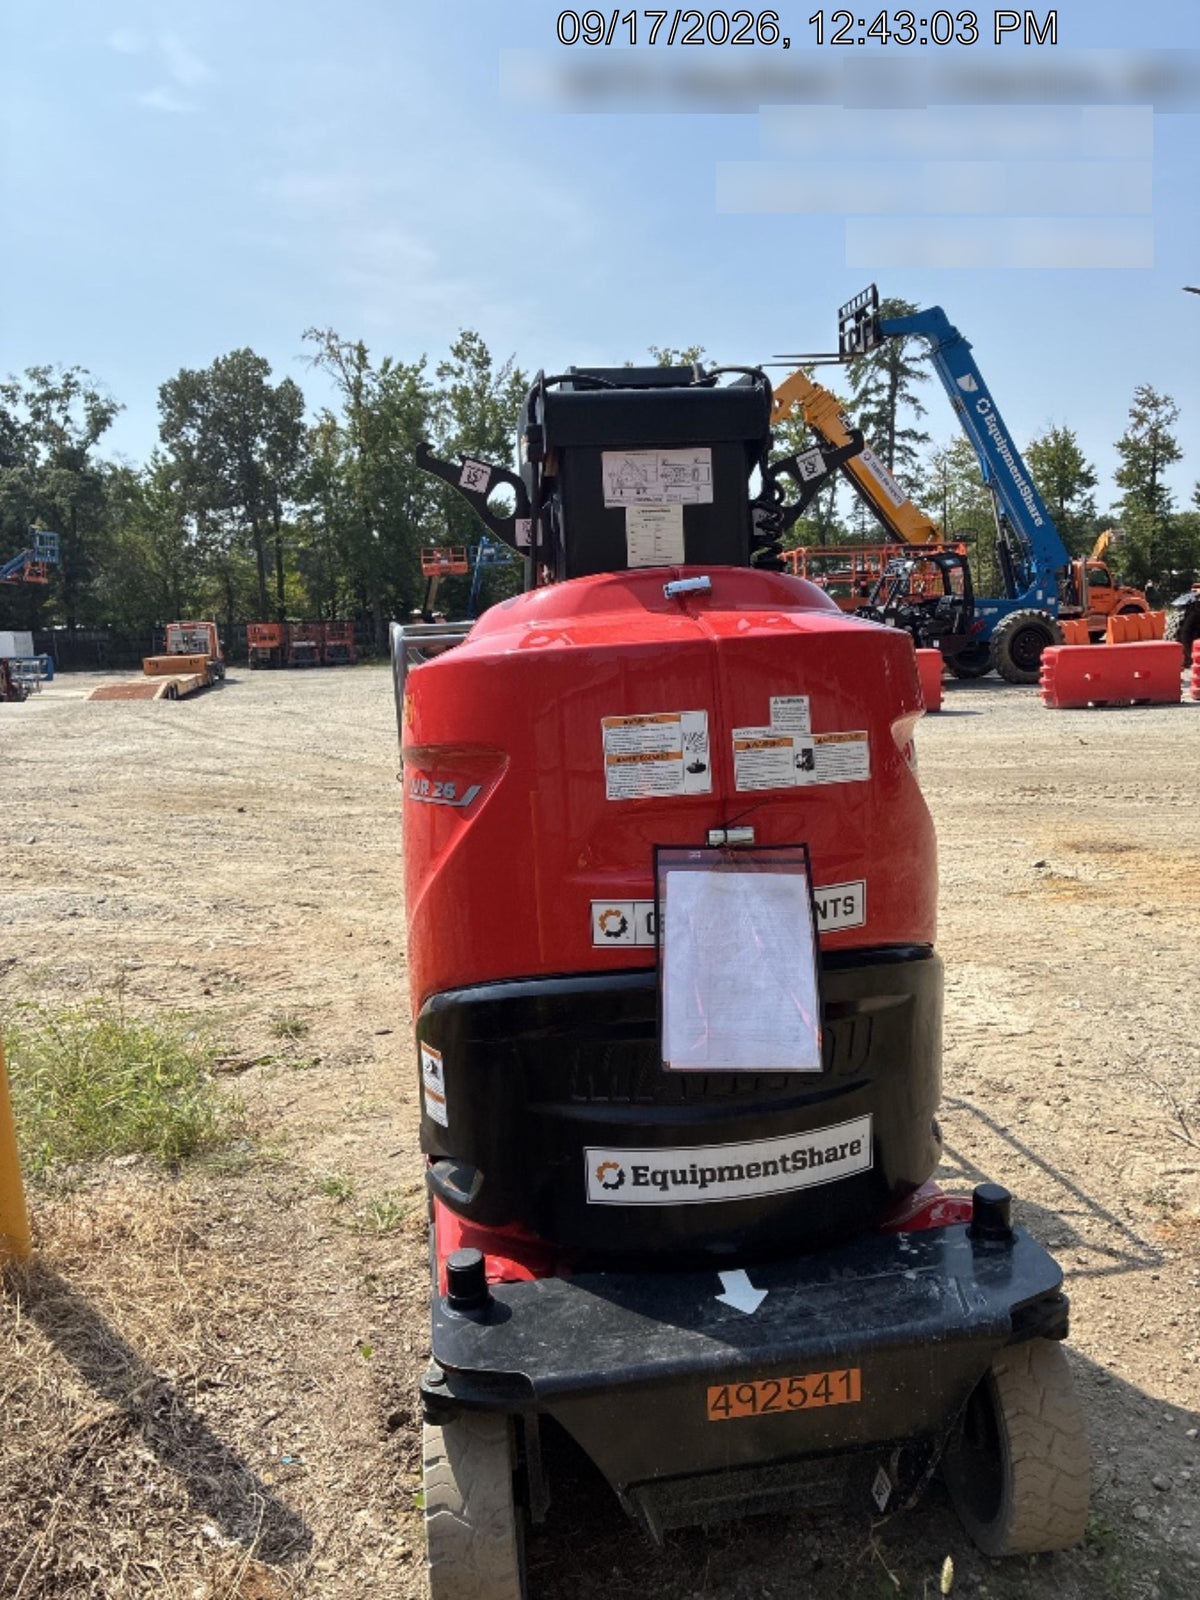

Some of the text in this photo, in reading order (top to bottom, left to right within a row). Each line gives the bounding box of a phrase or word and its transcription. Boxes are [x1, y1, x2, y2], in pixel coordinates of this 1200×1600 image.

[983, 412, 1044, 527] EquipmentShare
[432, 781, 456, 799] 26
[630, 1139, 863, 1191] EquipmentShare
[710, 1369, 852, 1417] 492541
